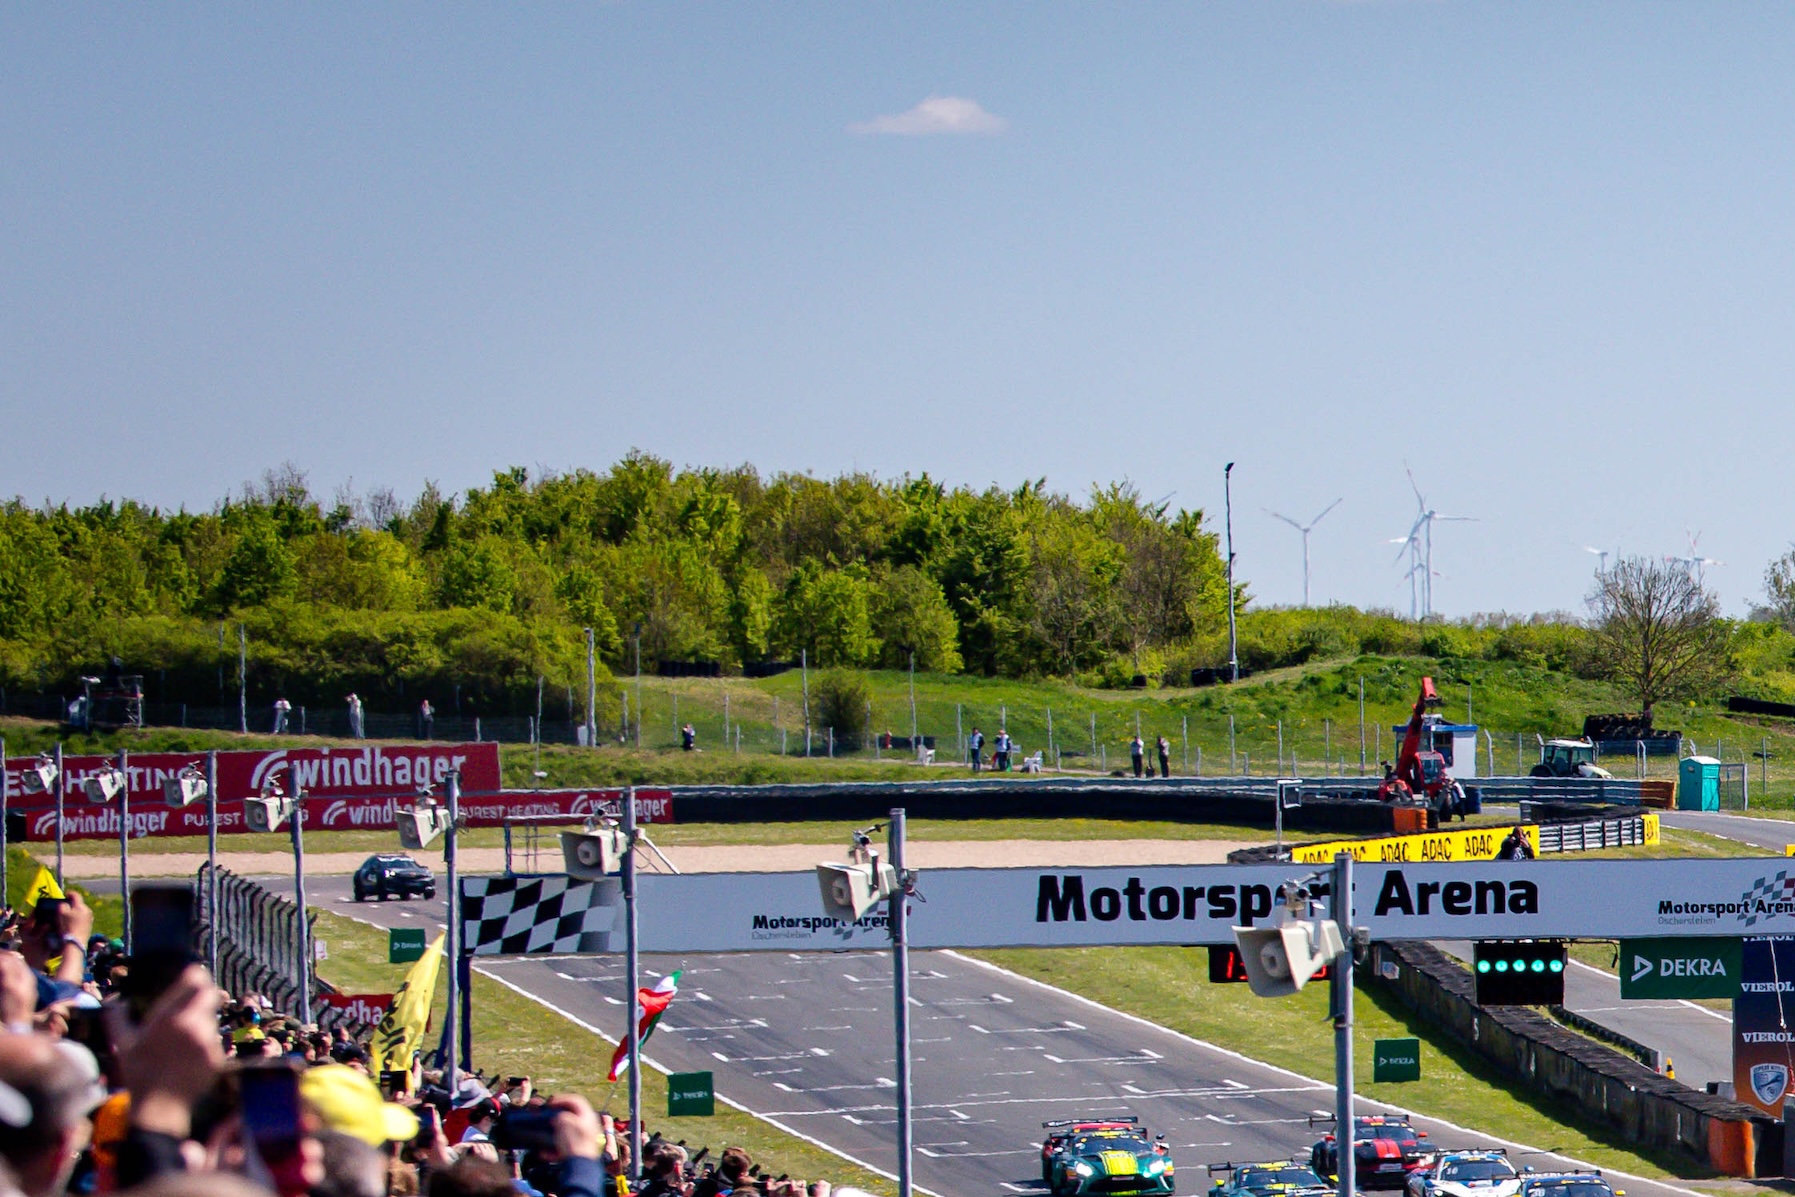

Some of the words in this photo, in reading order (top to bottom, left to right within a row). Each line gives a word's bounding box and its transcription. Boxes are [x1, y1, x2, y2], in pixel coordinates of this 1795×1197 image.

[294, 747, 466, 793] windhager
[1380, 842, 1410, 862] ADAC
[1422, 838, 1451, 861] ADAC
[1464, 834, 1493, 857] ADAC
[1373, 870, 1539, 916] Arena
[1658, 900, 1750, 919] Motorsport
[1660, 958, 1727, 977] DEKRA
[1741, 981, 1795, 993] VIEROL
[1742, 1031, 1795, 1043] VIEROL
